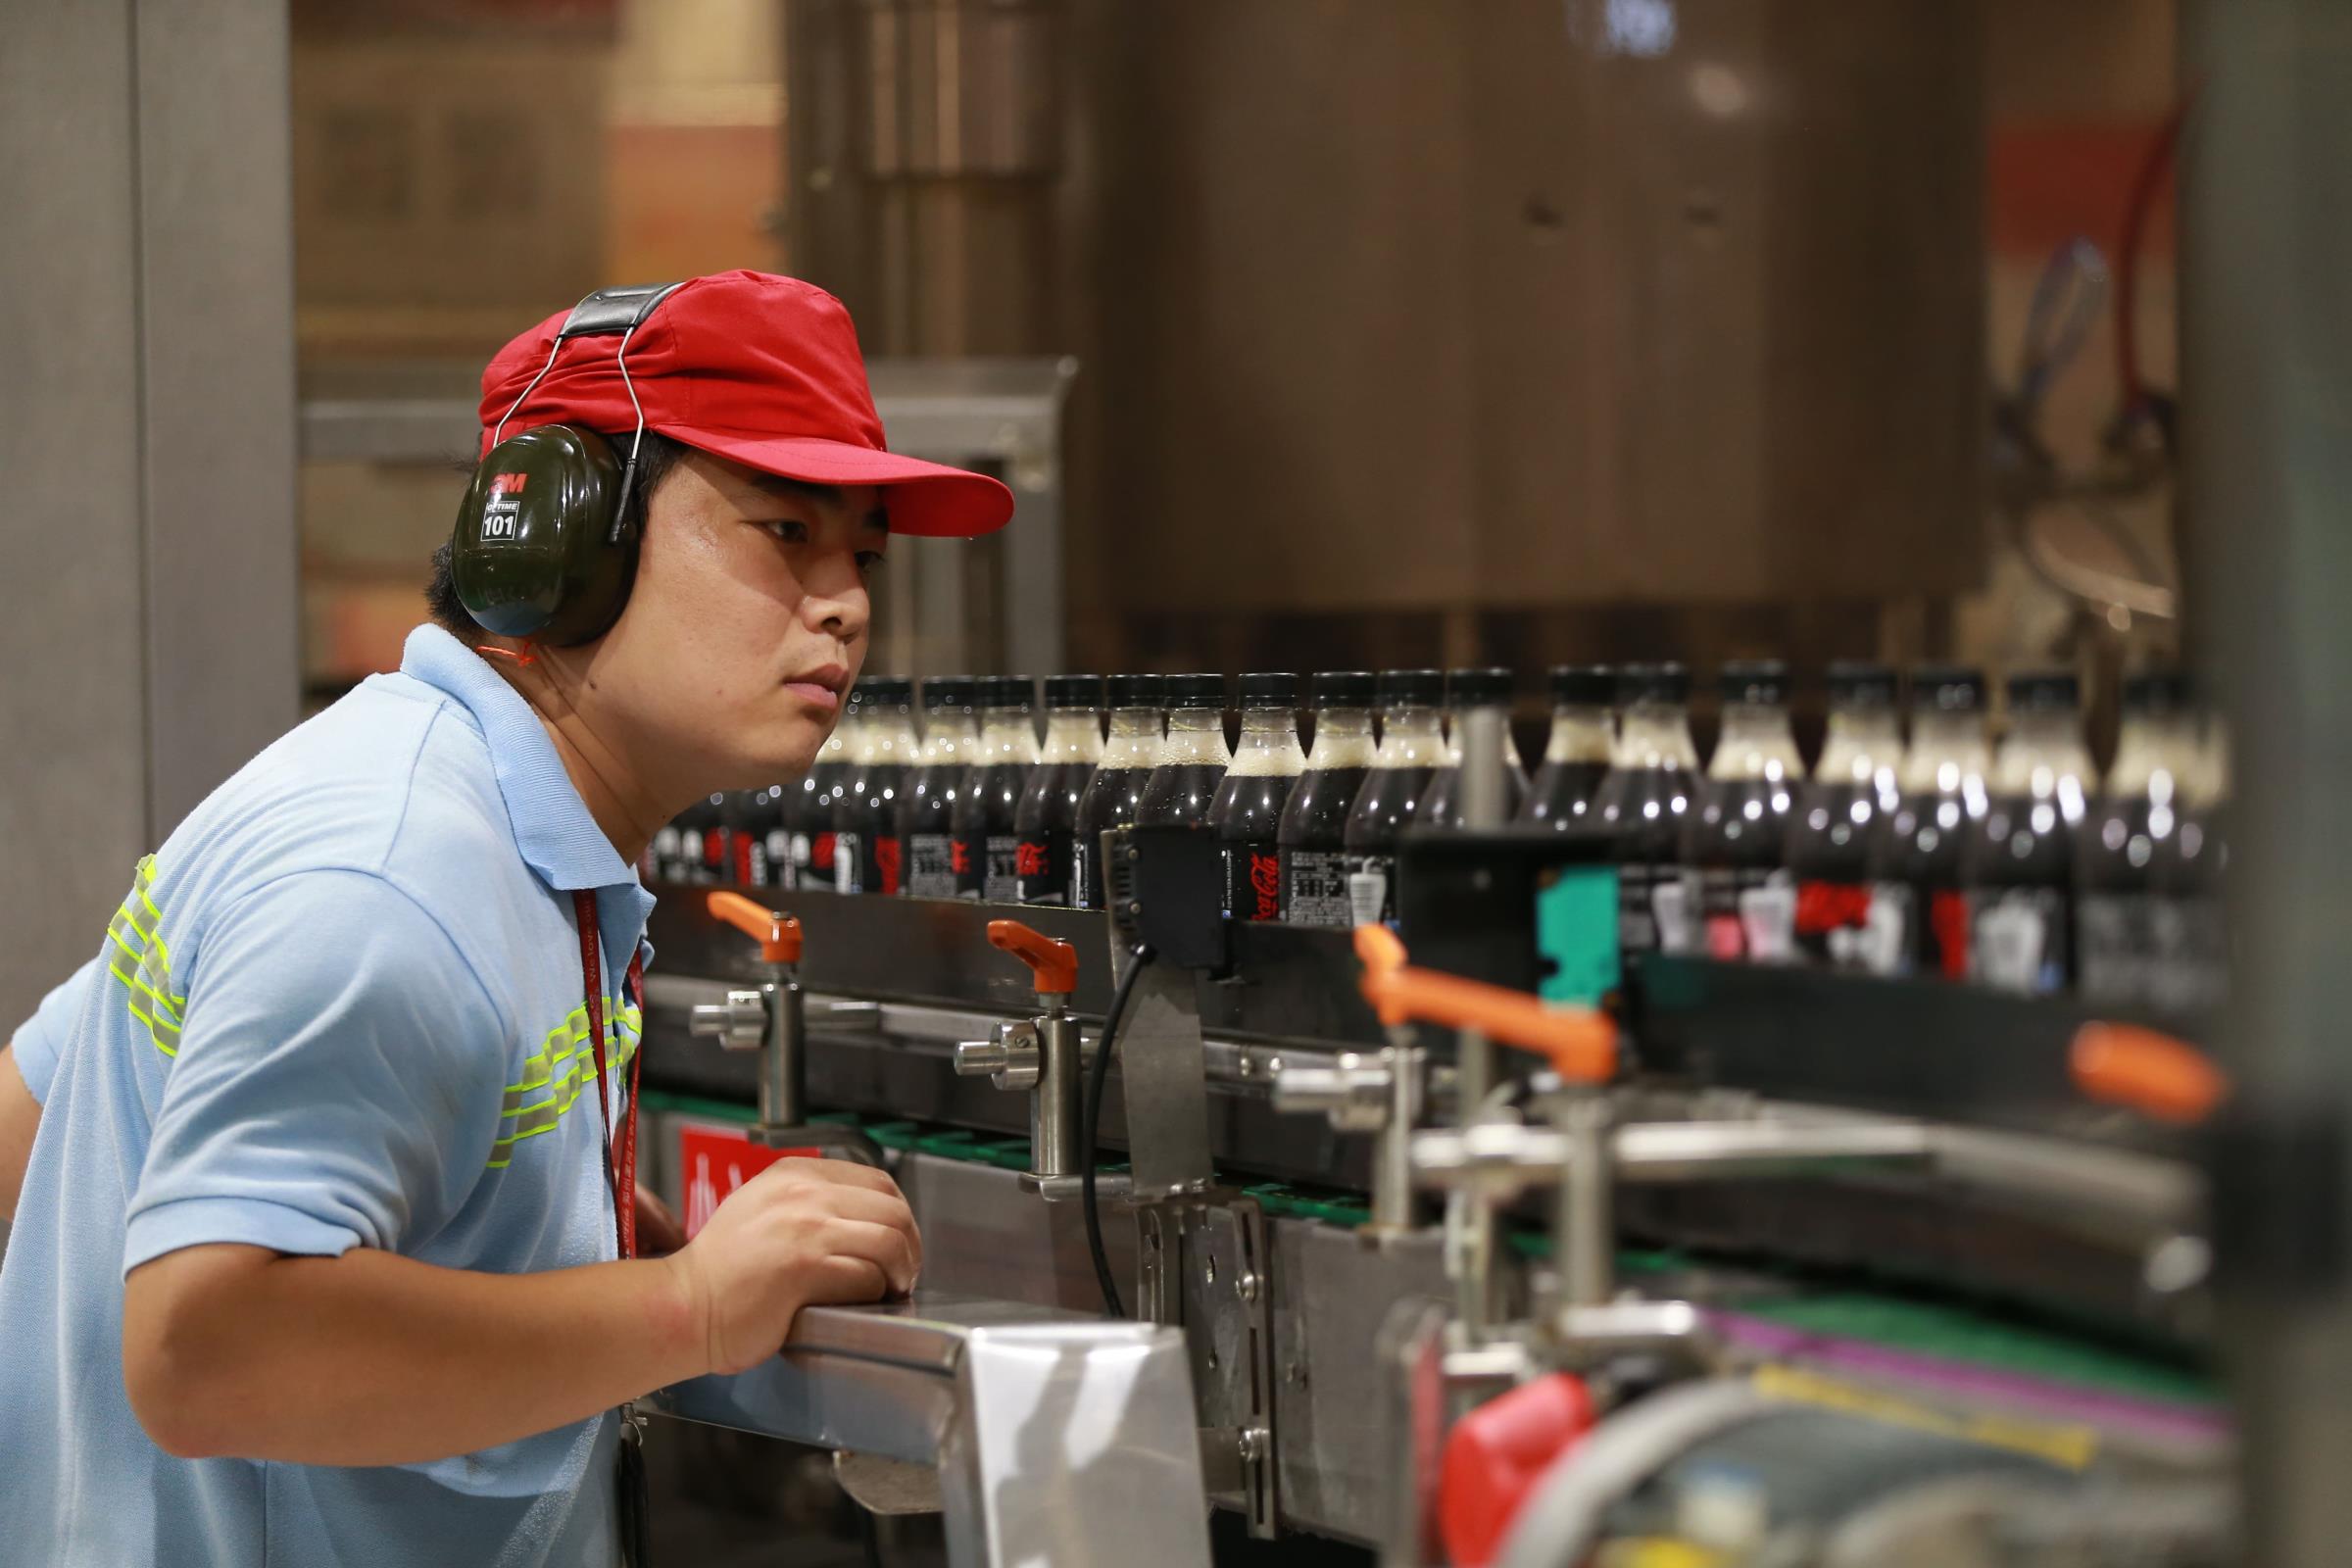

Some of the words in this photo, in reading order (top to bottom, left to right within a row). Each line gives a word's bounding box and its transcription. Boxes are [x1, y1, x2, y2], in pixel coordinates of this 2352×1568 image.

[490, 473, 528, 493] 3M
[485, 515, 514, 536] 101
[586, 925, 595, 956] love
[588, 959, 597, 983] We
